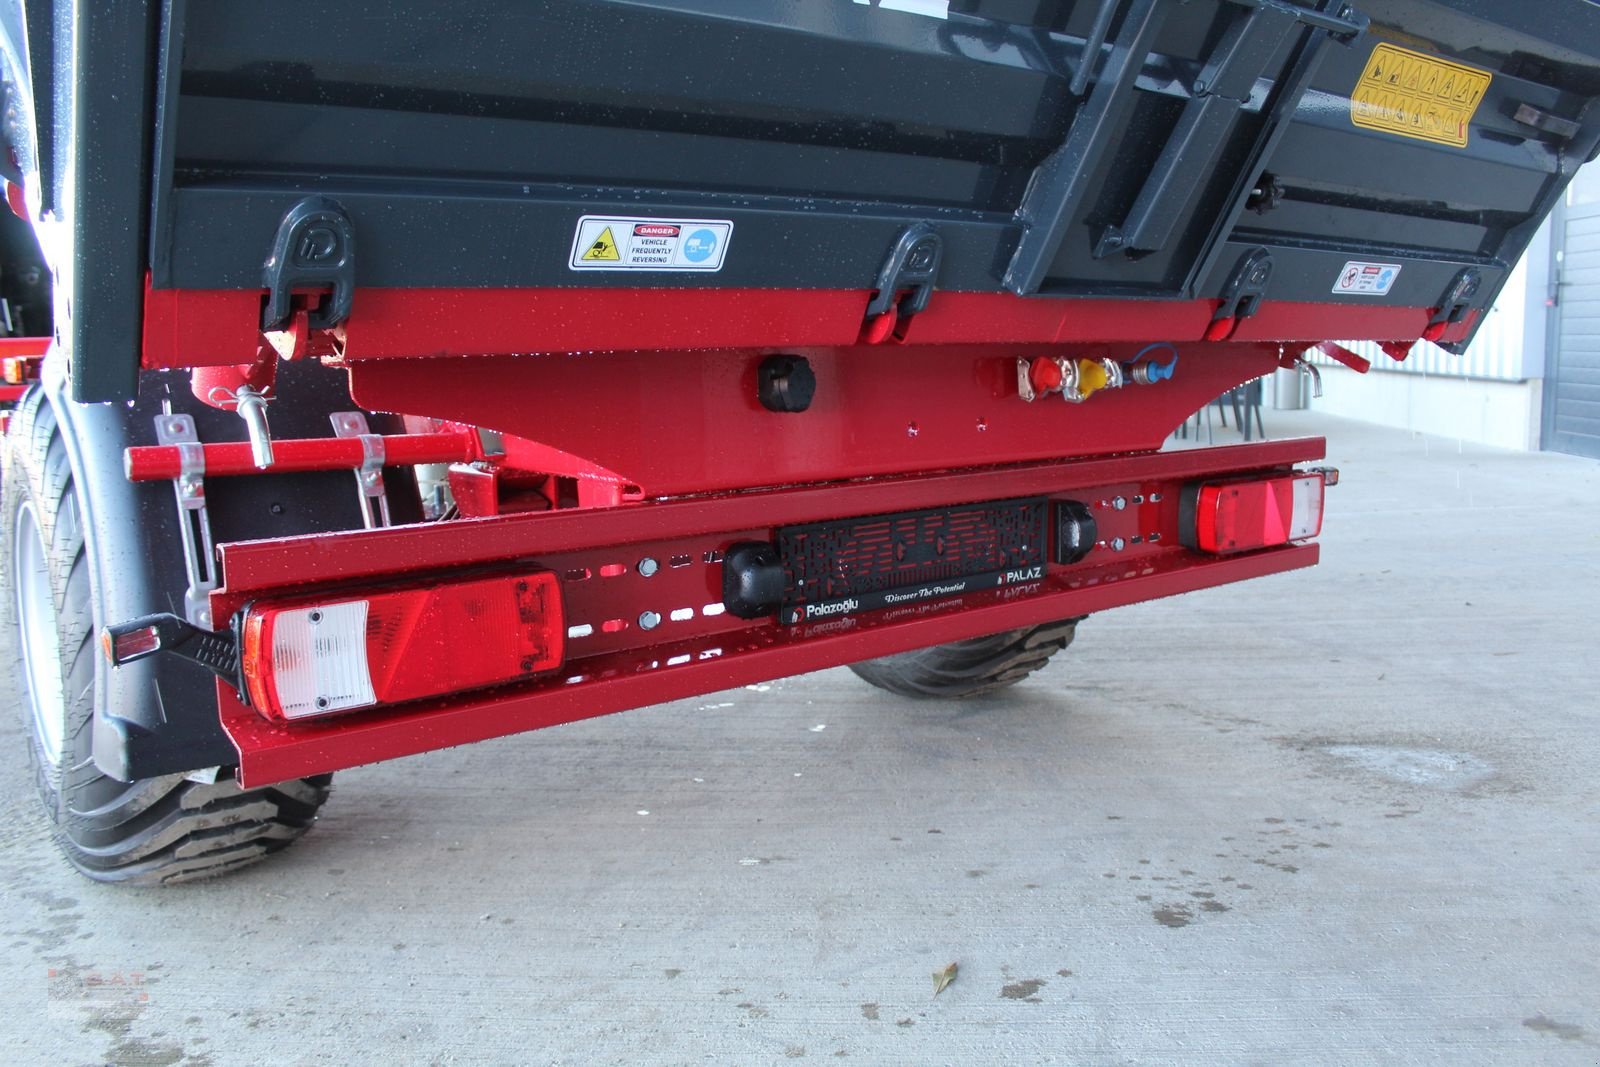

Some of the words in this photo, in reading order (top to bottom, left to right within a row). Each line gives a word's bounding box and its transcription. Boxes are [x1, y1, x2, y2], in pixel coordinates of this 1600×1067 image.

[641, 227, 674, 235] DANGER
[1007, 566, 1041, 583] PALAZ
[884, 592, 918, 603] Discover
[919, 588, 933, 597] The
[933, 581, 966, 595] Potential
[806, 598, 859, 618] Palazoğlu
